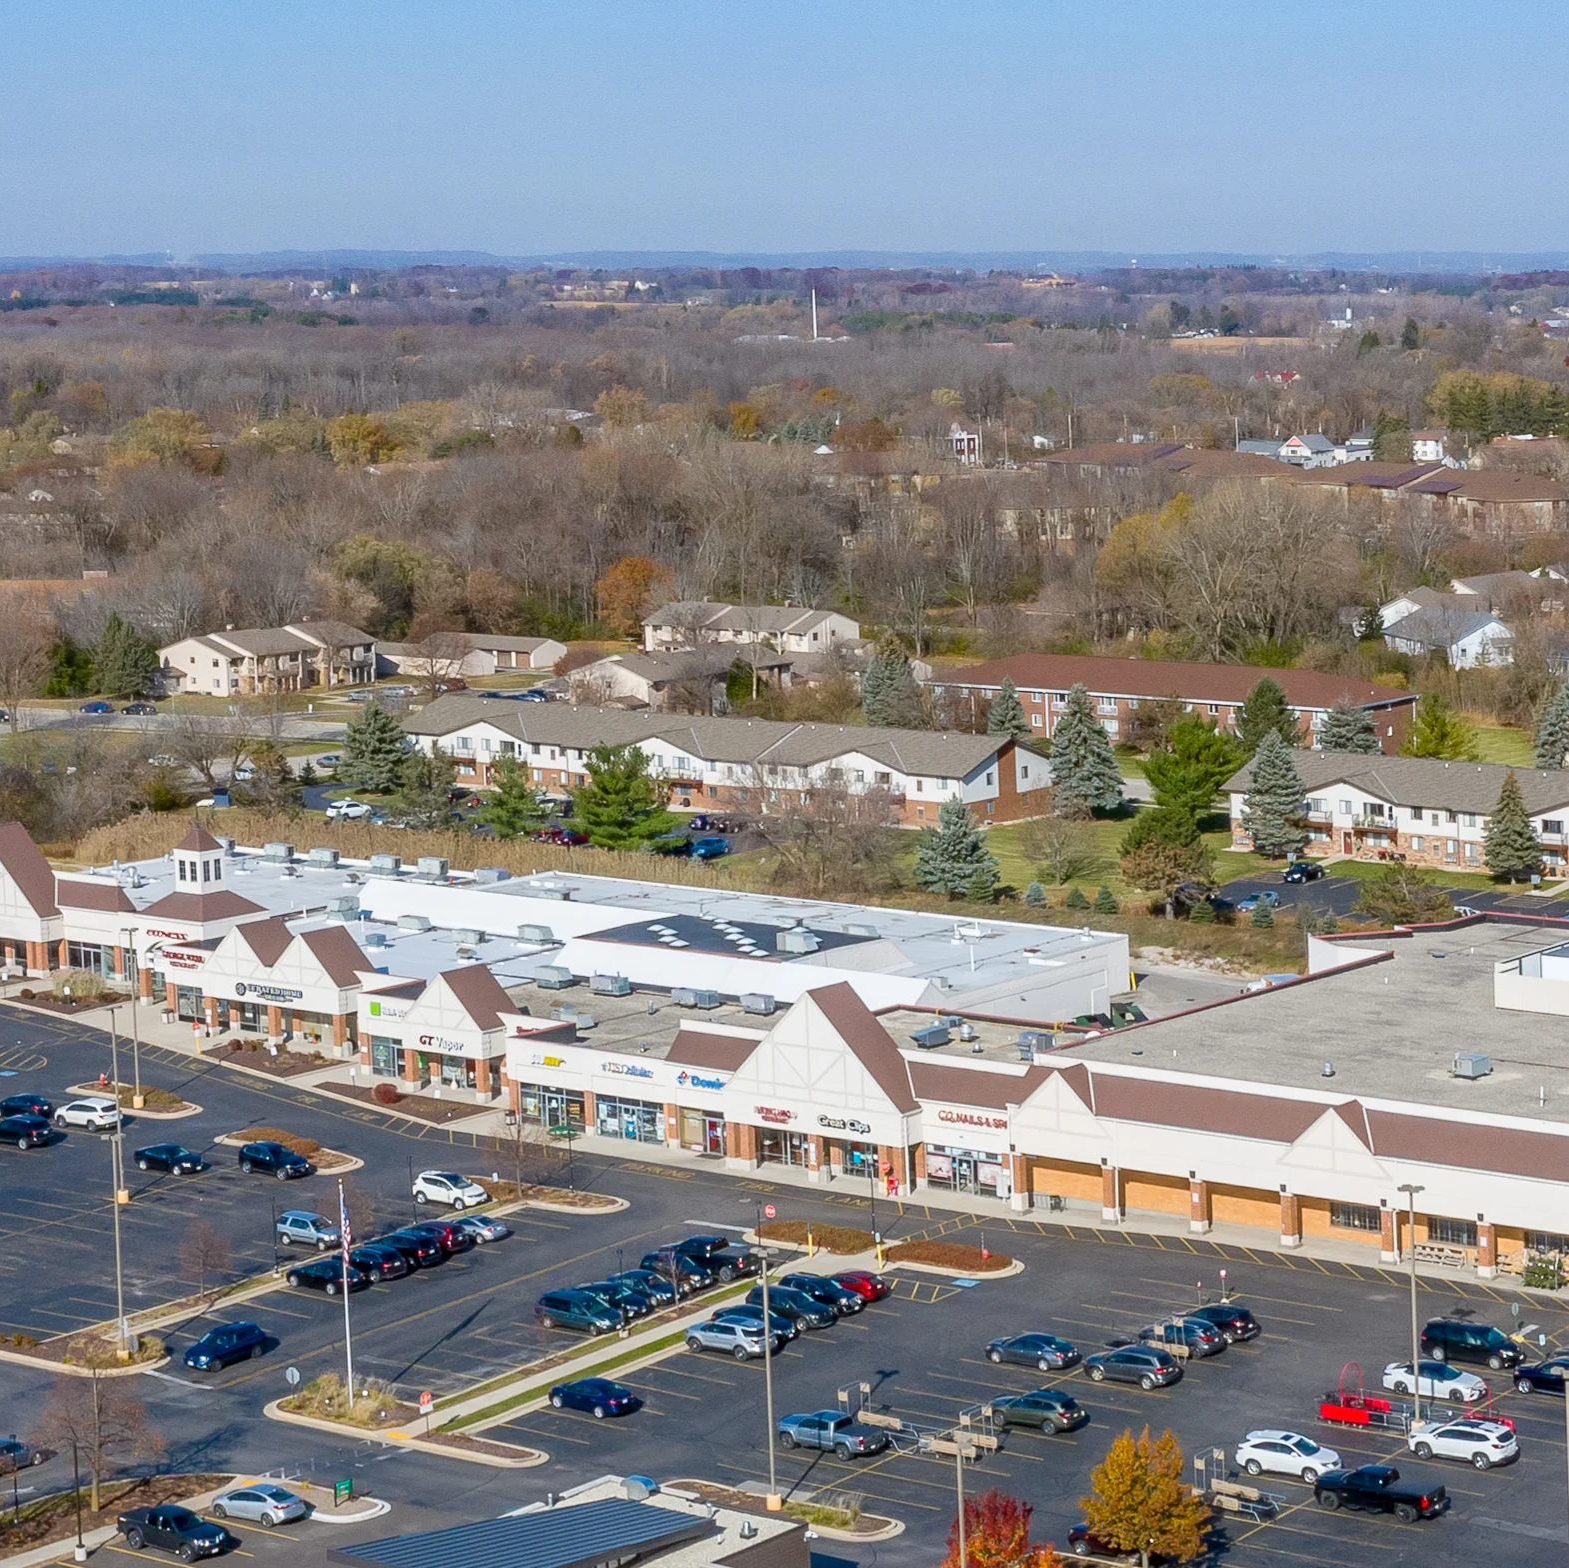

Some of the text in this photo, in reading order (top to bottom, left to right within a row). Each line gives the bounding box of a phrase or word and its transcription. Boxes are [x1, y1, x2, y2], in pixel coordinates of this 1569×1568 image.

[419, 1035, 464, 1052] GT Vapor
[817, 1114, 871, 1135] Great Clips
